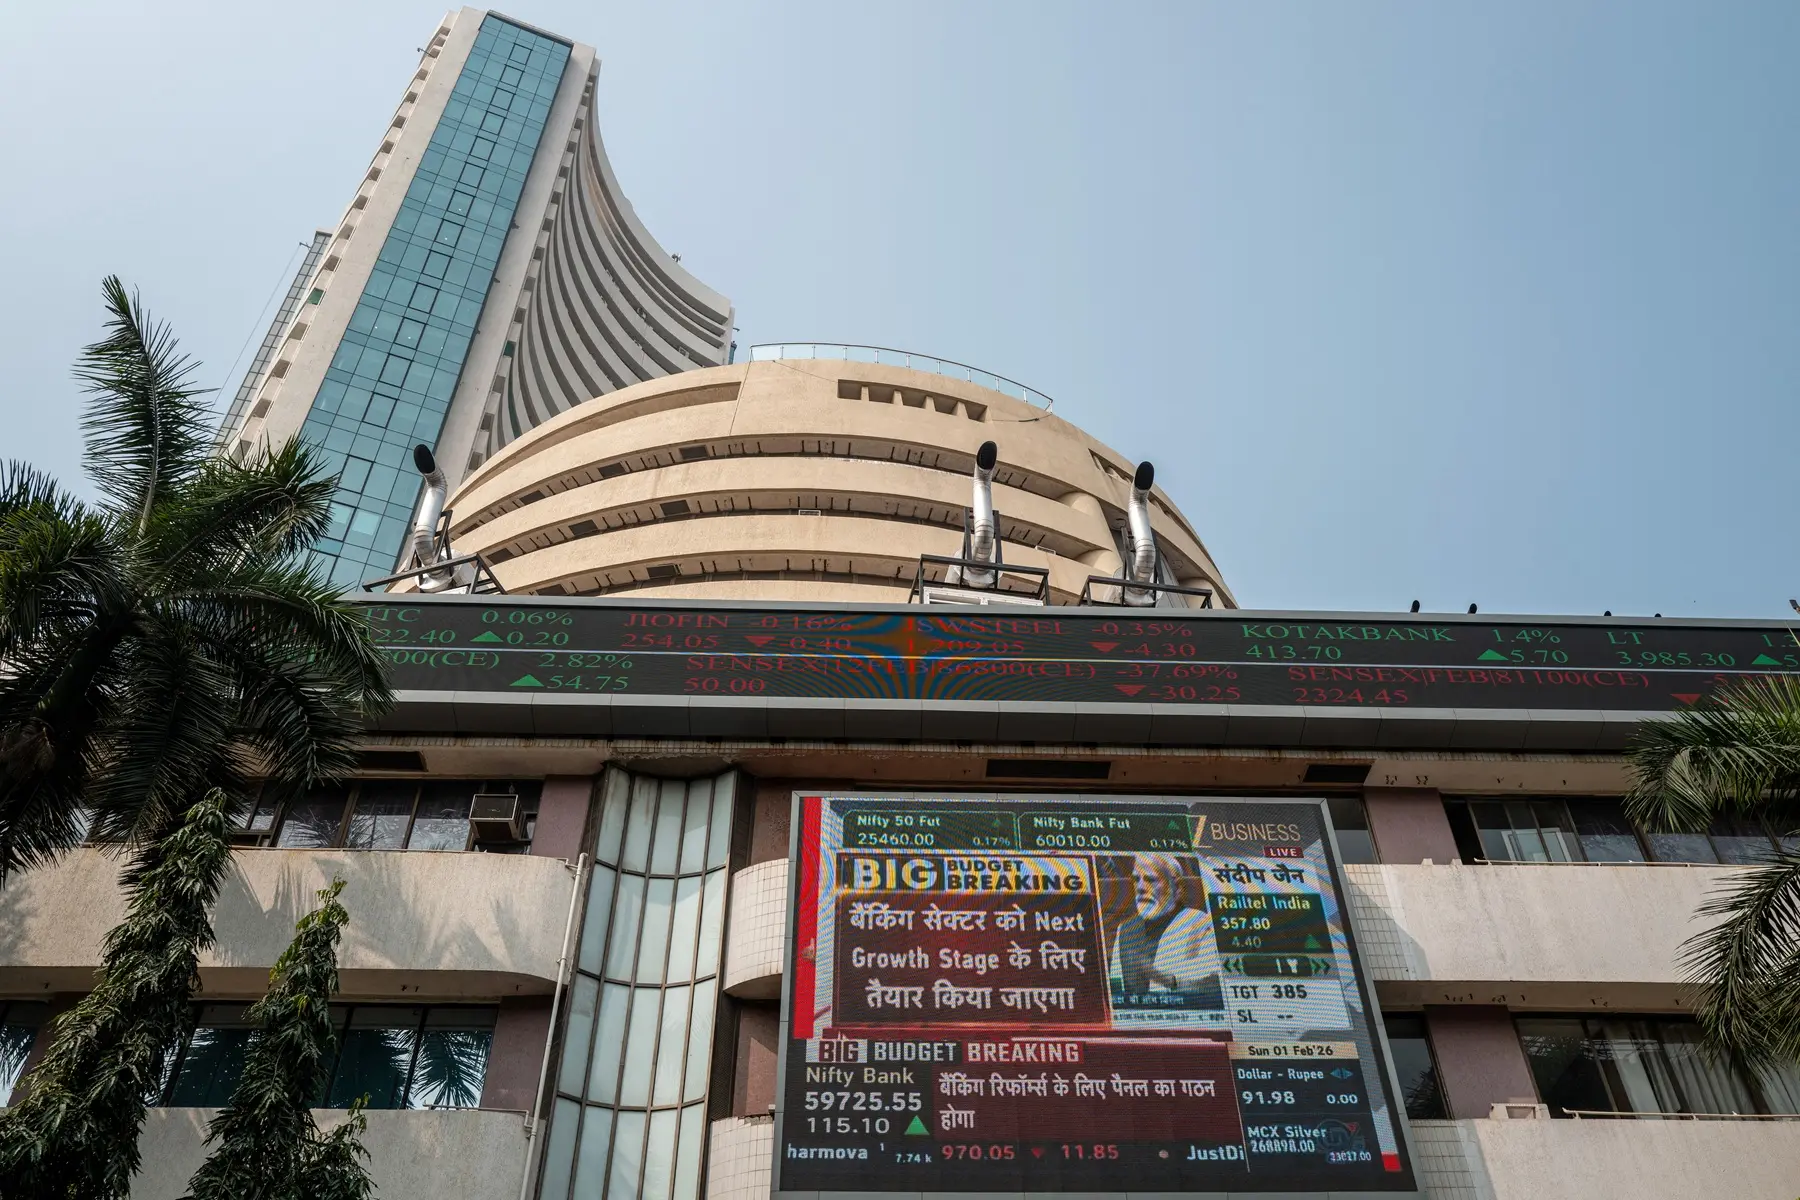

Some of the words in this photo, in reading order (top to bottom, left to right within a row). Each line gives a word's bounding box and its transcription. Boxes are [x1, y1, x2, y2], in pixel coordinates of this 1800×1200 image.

[365, 608, 421, 622] ITC
[482, 610, 573, 626] 0.06%
[624, 613, 730, 629] JIOFIN
[750, 615, 853, 631] -0.16%
[1092, 622, 1192, 637] -0.35%
[1241, 625, 1457, 642] KOTAKBANK
[1492, 629, 1561, 644] 1.4%
[1606, 631, 1645, 645] LT
[506, 631, 569, 646] 0.20
[621, 633, 720, 649] 254.05
[780, 637, 851, 651] -0.40
[1124, 643, 1197, 658] -4.30
[1246, 645, 1342, 660] 413.70
[1510, 649, 1570, 664] 5.70
[538, 653, 633, 669] 2.82%
[1615, 651, 1736, 668] 3,985.30
[1115, 663, 1239, 681] -37.69%
[546, 675, 630, 690] 54.75
[683, 677, 766, 693] 50.00
[1148, 684, 1242, 701] -30.25
[1292, 688, 1409, 704] 2324.45
[856, 814, 888, 828] Nifty
[895, 815, 913, 827] 50
[920, 816, 940, 828] Fut
[1033, 816, 1064, 831] Nifty
[1070, 817, 1103, 830] Bank
[1109, 818, 1131, 830] Fut
[857, 832, 935, 847] 25460.00
[1210, 822, 1301, 842] BUSINESS
[1035, 834, 1111, 849] 60010.00
[1269, 847, 1298, 857] LIVE
[853, 857, 938, 890] BIG
[946, 859, 1023, 872] BUDGET
[1213, 863, 1266, 885] संदीप
[1271, 863, 1305, 884] जैन
[946, 874, 1083, 891] BREAKING
[1217, 895, 1267, 911] Railtel
[1272, 896, 1311, 911] India
[921, 903, 987, 932] सेक्टर
[993, 903, 1025, 932] को
[1034, 911, 1086, 932] Next
[1221, 917, 1271, 931] 357.80
[851, 946, 930, 969] Growth
[938, 947, 1000, 975] Stage
[1007, 940, 1032, 970] के
[1038, 940, 1086, 974] लिए
[865, 977, 924, 1010] तैयार
[931, 977, 992, 1010] किया
[999, 987, 1076, 1013] जाएगा
[1230, 985, 1259, 1000] TGT
[1272, 984, 1308, 1000] 385
[1237, 1009, 1258, 1023] SL
[819, 1040, 859, 1062] BIG
[874, 1042, 957, 1061] BUDGET
[967, 1043, 1080, 1063] BREAKING
[1248, 1046, 1269, 1056] Sun
[1273, 1046, 1288, 1056] 01
[1293, 1046, 1333, 1056] Feb'26
[806, 1066, 854, 1087] Nifty
[863, 1067, 914, 1084] Bank
[1237, 1068, 1272, 1079] Dollar
[1287, 1068, 1324, 1082] Rupee
[938, 1072, 985, 1096] बैंकिंग
[1052, 1073, 1069, 1096] के
[1073, 1073, 1106, 1099] लिए
[1110, 1073, 1149, 1097] पैनल
[1152, 1079, 1176, 1097] का
[1179, 1079, 1216, 1097] गठन
[804, 1091, 922, 1111] 59725.55
[1242, 1091, 1295, 1104] 91.98
[1326, 1094, 1358, 1104] 0.00
[807, 1117, 890, 1134] 115.10
[939, 1104, 975, 1130] होगा
[1247, 1126, 1280, 1138] MCX
[1284, 1125, 1327, 1138] Silver
[787, 1143, 868, 1159] harmova
[896, 1154, 921, 1163] 7.74
[941, 1145, 1015, 1160] 970.05
[1061, 1144, 1119, 1160] 11.85
[1187, 1145, 1245, 1161] JustDi
